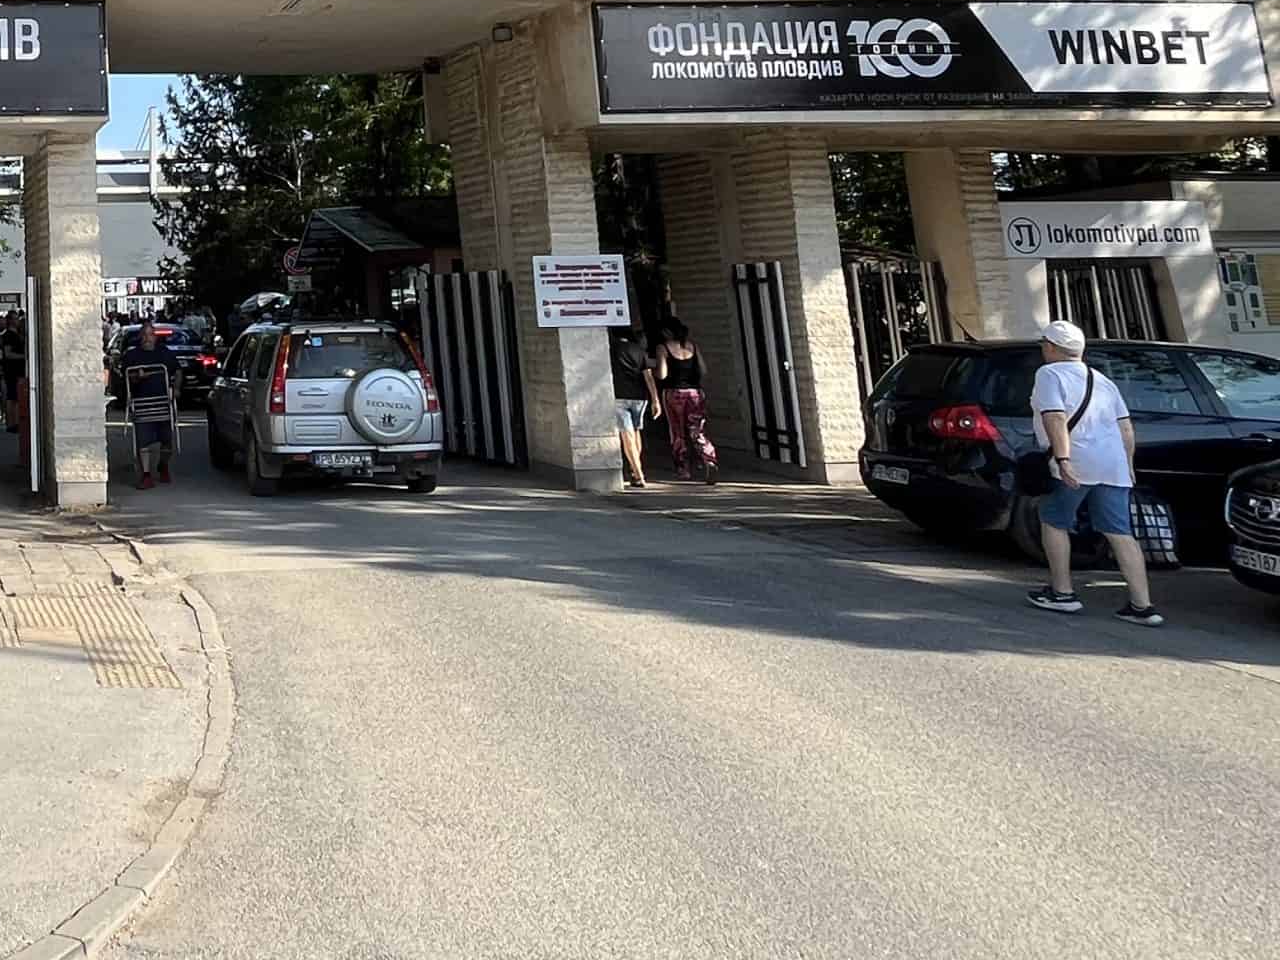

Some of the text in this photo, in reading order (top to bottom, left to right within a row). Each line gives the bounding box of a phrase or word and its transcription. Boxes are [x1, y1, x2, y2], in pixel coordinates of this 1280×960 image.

[647, 19, 840, 62] ФОНДАЦИЯ
[1047, 28, 1210, 65] WINBET
[650, 60, 844, 81] ЛОКОМОТИВ ПЛОВДИВ
[1046, 223, 1201, 246] lokomotivpd.com
[365, 399, 413, 410] HONDA
